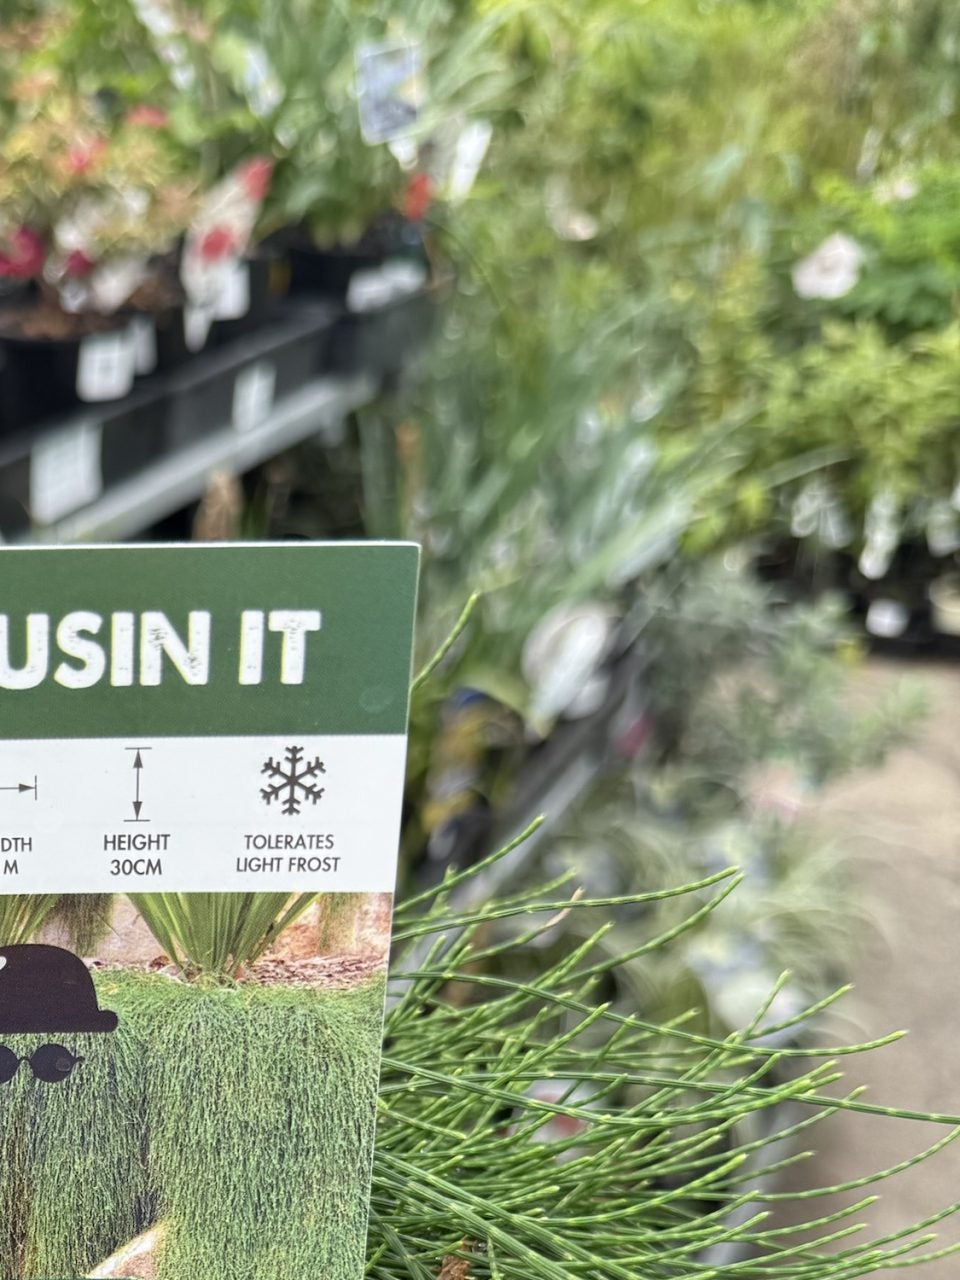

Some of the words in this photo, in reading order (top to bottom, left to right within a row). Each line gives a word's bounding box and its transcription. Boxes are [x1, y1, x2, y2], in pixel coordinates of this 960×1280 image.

[239, 610, 321, 685] IT
[104, 834, 170, 850] HEIGHT
[245, 835, 333, 849] TOLERATES
[111, 859, 161, 875] 30CM
[237, 857, 283, 872] LIGHT
[289, 857, 340, 871] FROST
